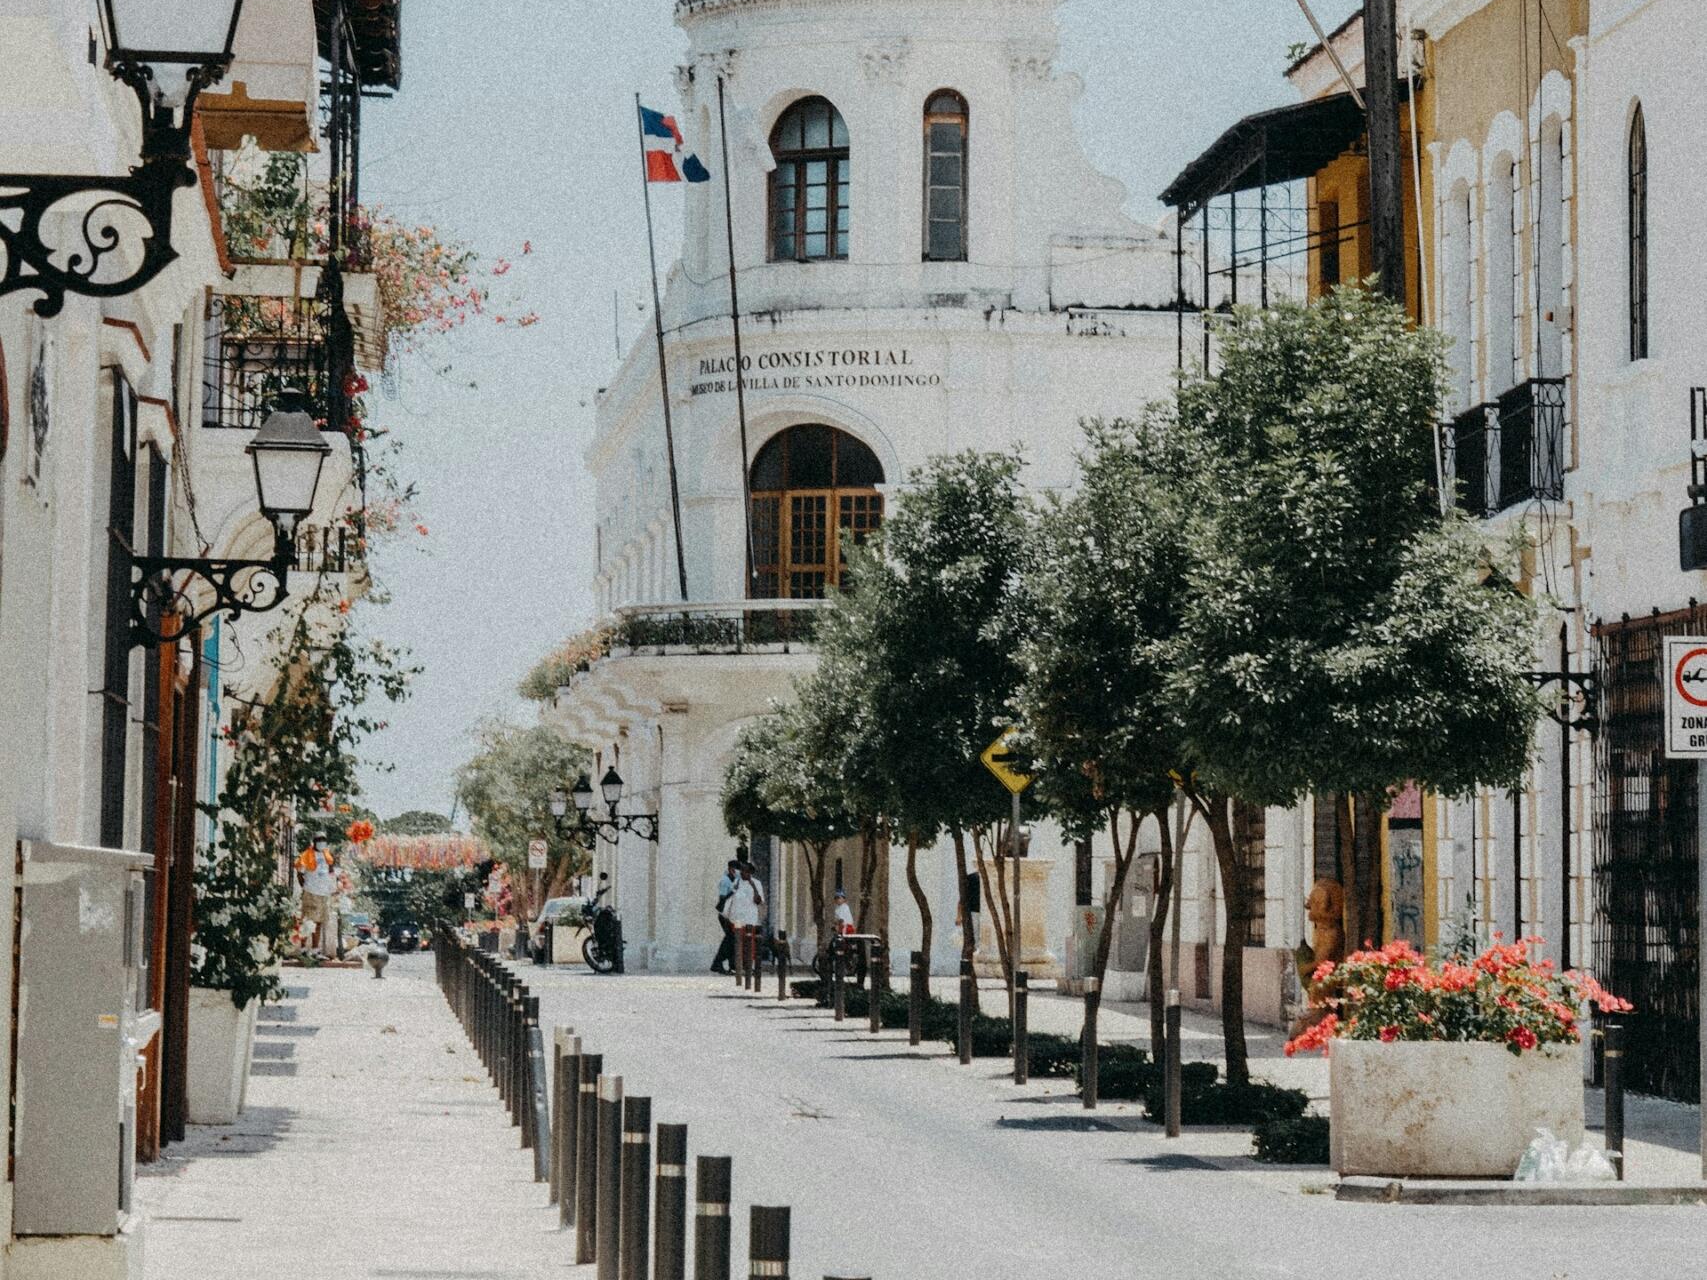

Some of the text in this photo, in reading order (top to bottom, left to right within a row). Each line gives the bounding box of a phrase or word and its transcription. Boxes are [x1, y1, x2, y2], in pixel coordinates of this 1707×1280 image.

[699, 349, 913, 376] PALACO CONSISTORIAL
[741, 377, 779, 390] VILLA
[783, 376, 801, 389] DE
[805, 374, 856, 388] SANTO
[859, 373, 940, 387] DOMINGO
[1690, 734, 1707, 747] GR
